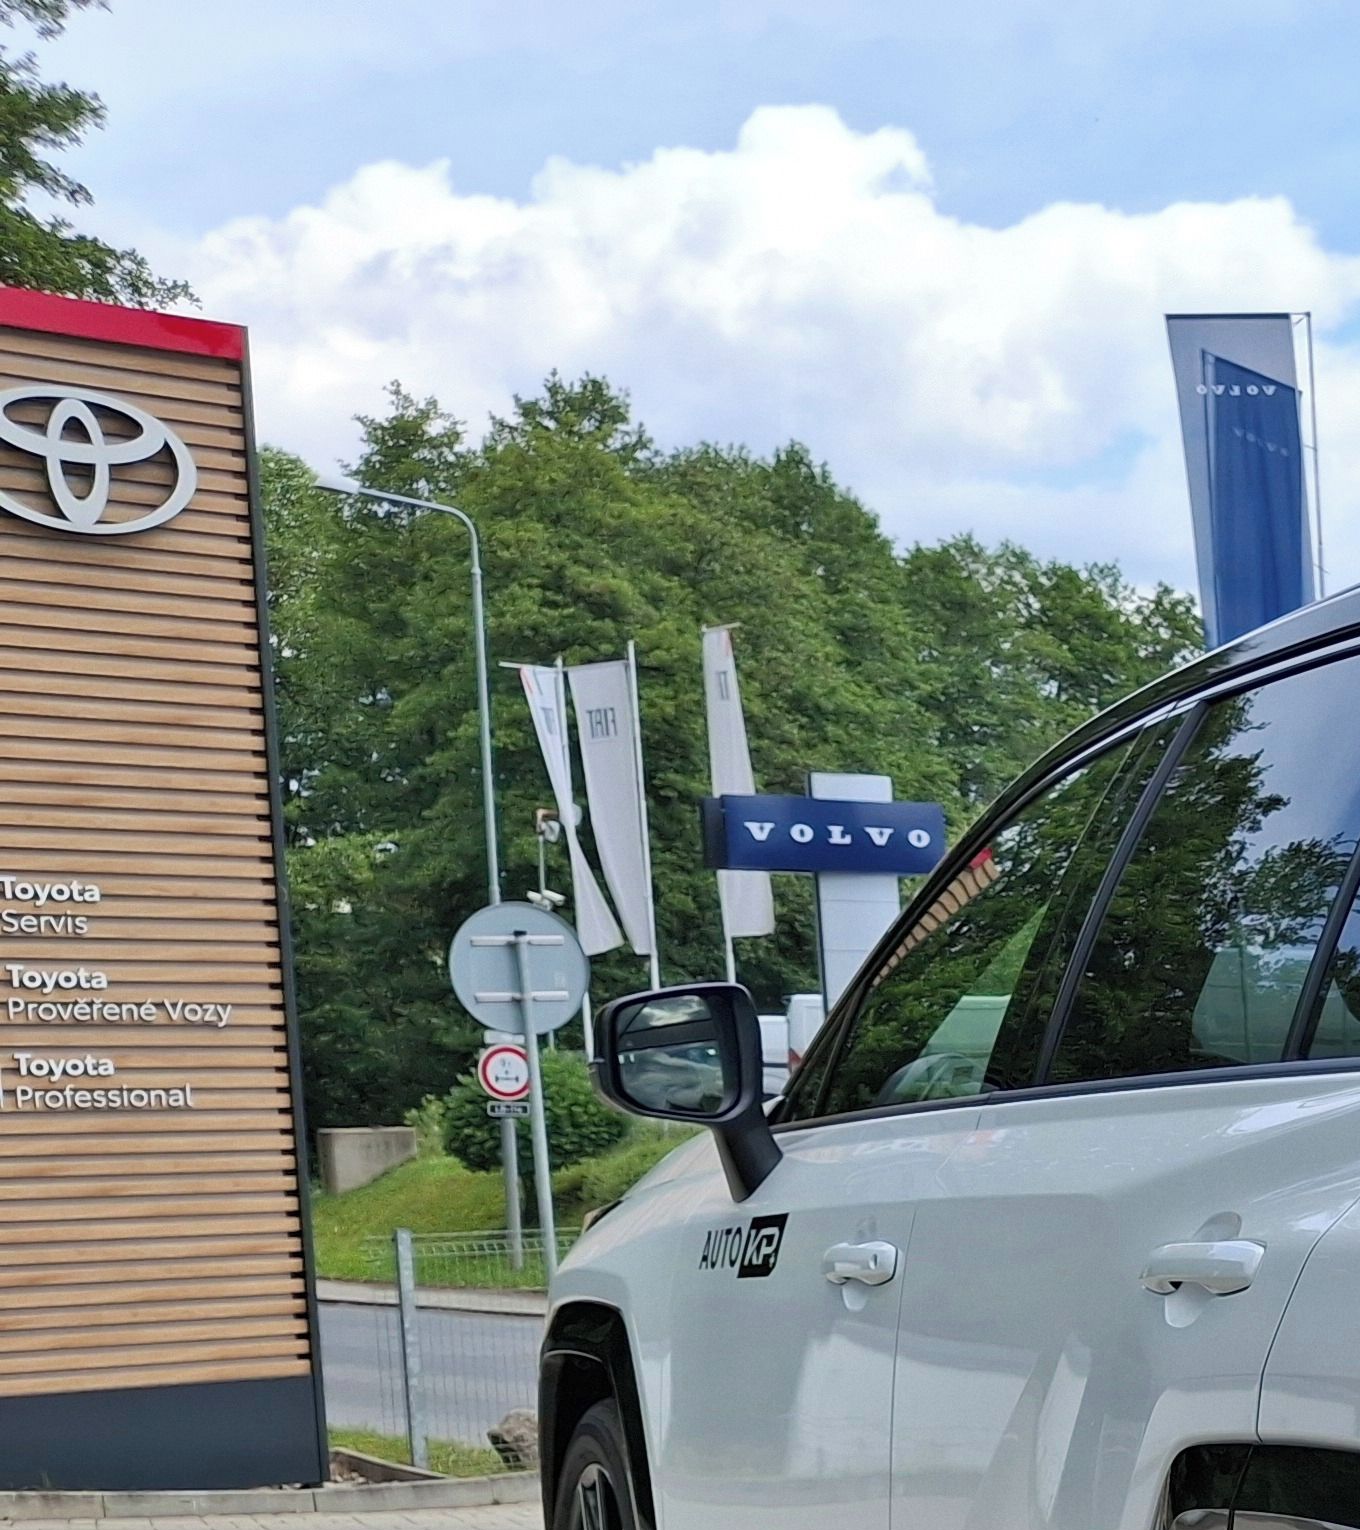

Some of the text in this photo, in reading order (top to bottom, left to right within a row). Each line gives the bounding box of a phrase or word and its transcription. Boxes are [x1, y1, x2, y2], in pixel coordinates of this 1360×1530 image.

[743, 821, 932, 849] VOLVO
[0, 876, 101, 907] Toyota
[1, 909, 89, 935] Servis
[5, 964, 108, 993] Toyota
[8, 998, 232, 1027] Prověřené Vozy
[14, 1053, 116, 1082] Toyota
[16, 1083, 194, 1109] Professional
[699, 1227, 742, 1270] AUTO
